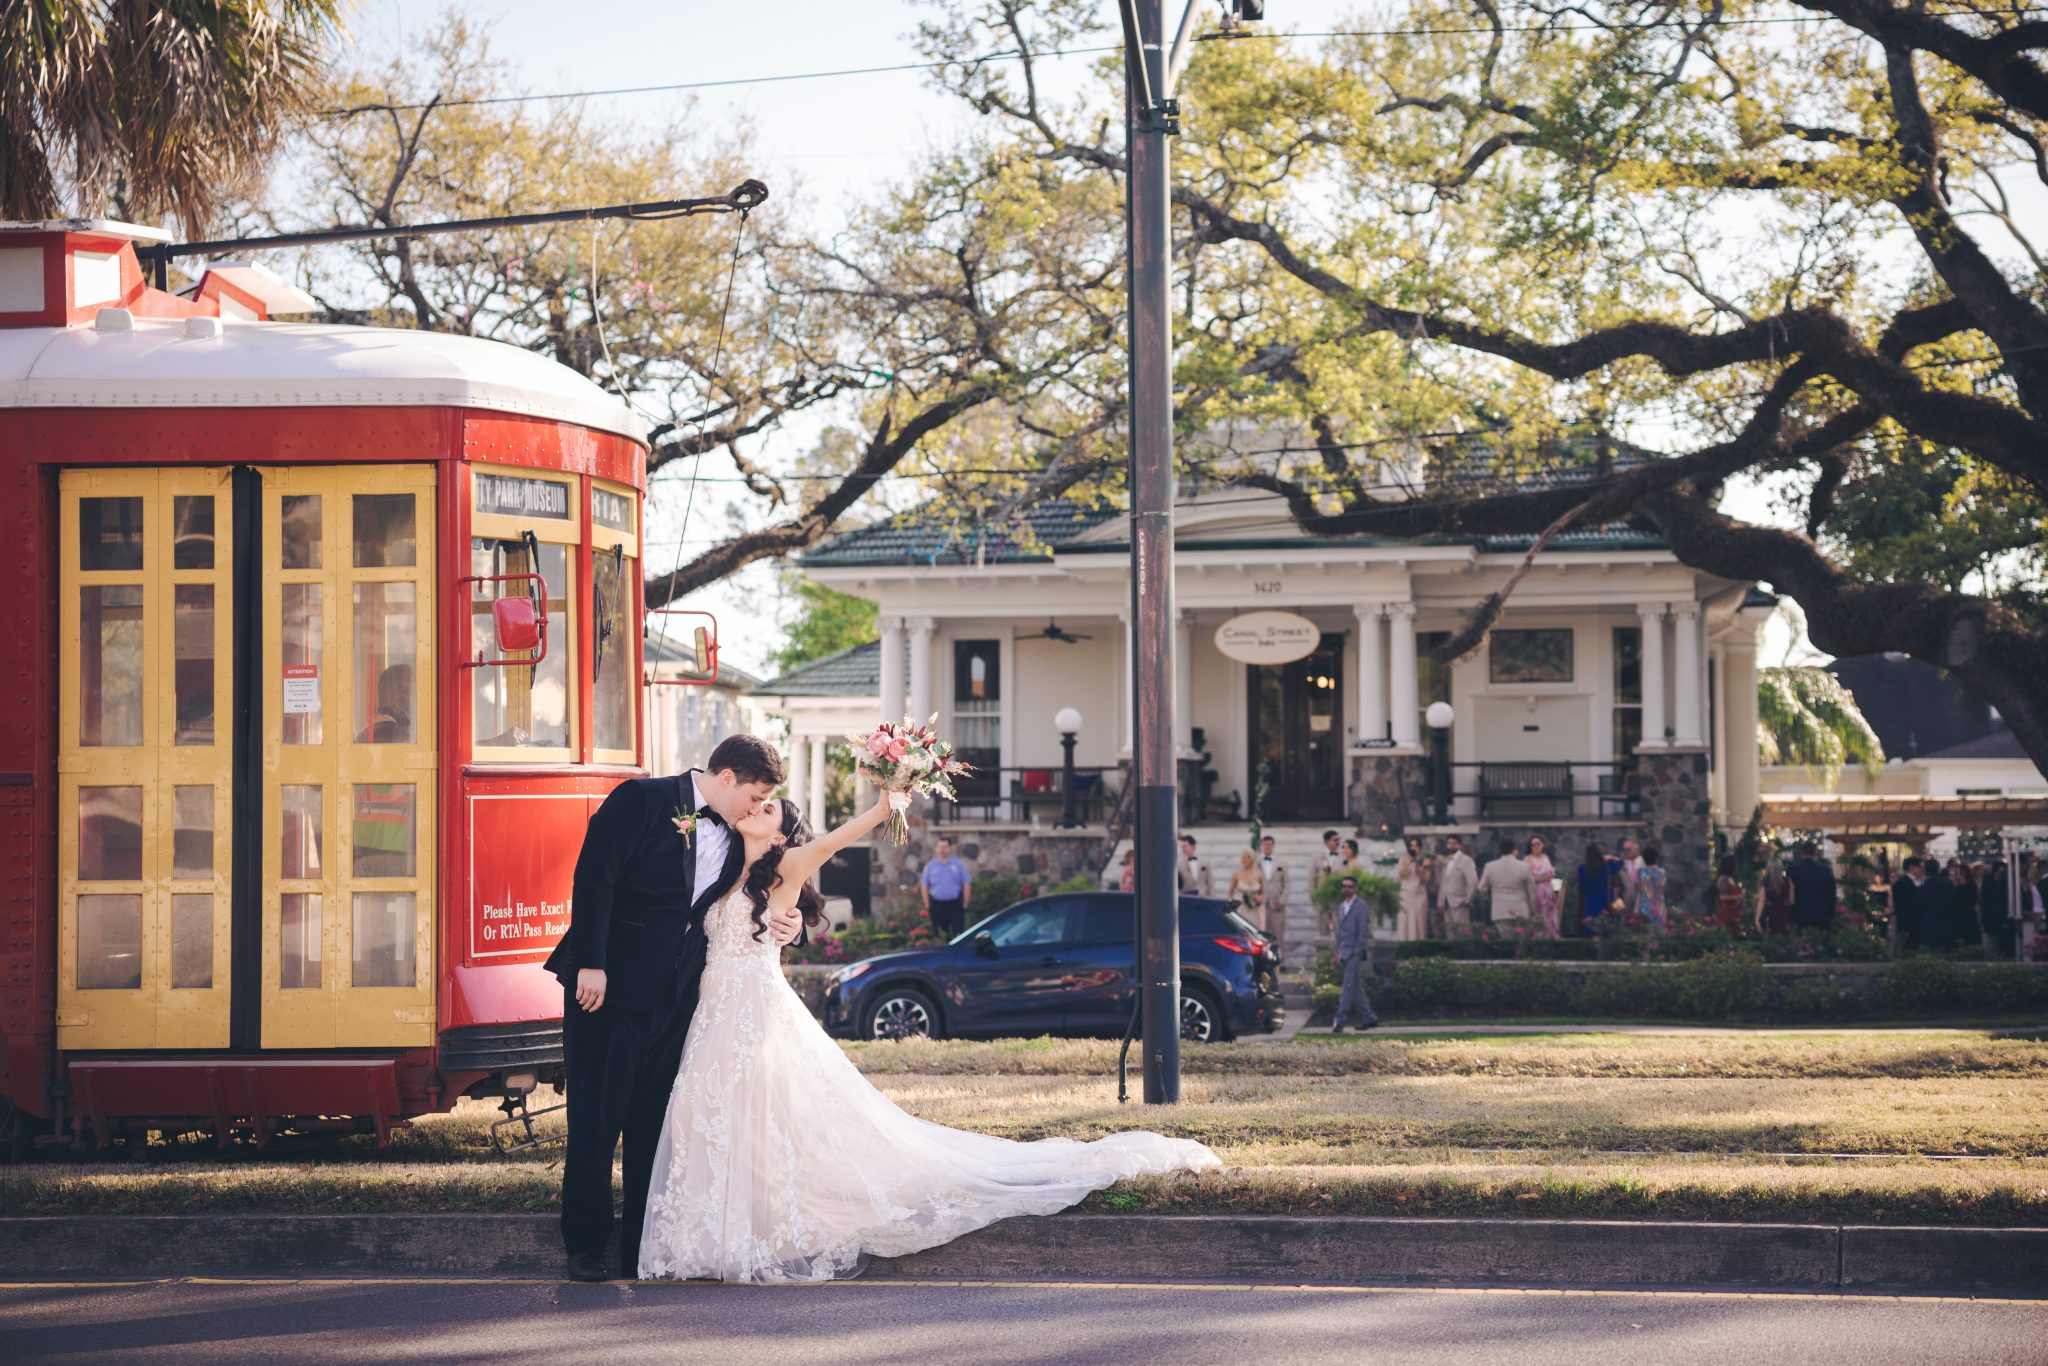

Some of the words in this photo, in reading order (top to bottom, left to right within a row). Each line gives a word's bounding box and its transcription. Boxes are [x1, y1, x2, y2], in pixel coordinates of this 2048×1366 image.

[592, 491, 621, 522] RTA
[483, 904, 513, 919] Please
[516, 902, 538, 917] Have
[540, 901, 564, 916] Exact
[483, 925, 497, 940] Or
[500, 924, 520, 939] RTA
[523, 922, 542, 937] Pass
